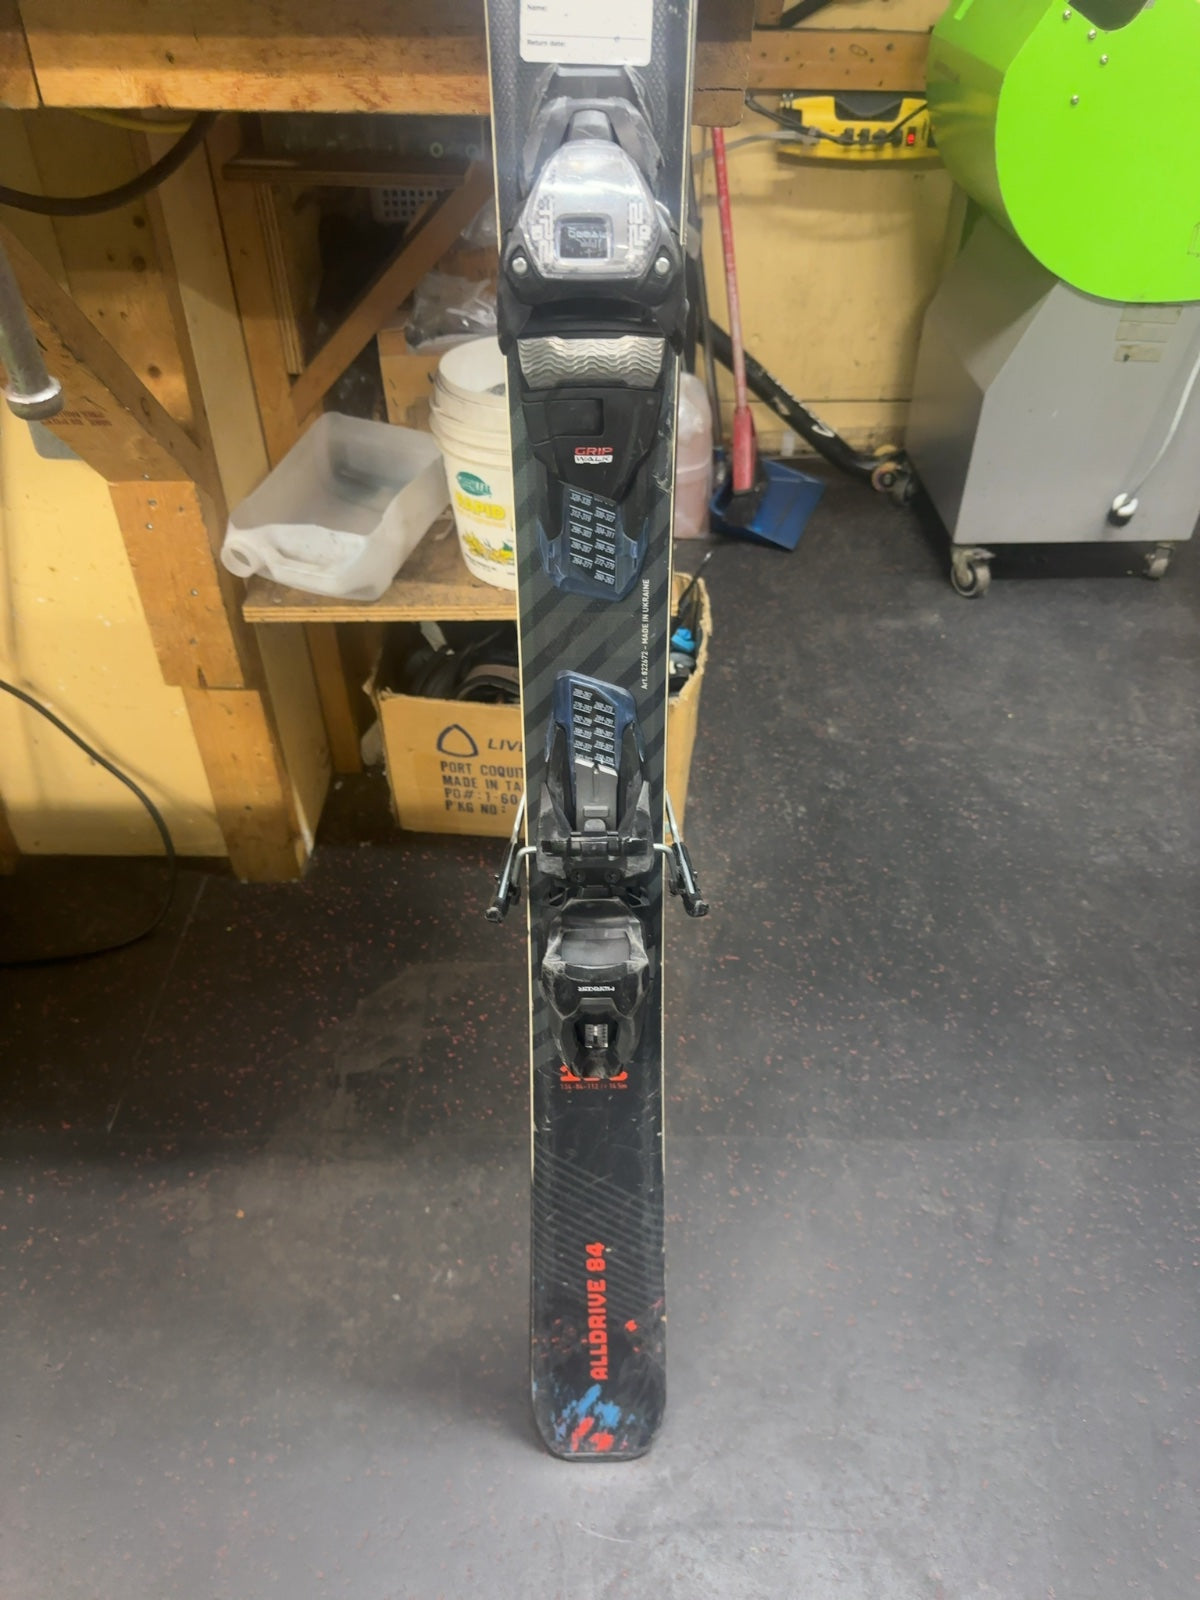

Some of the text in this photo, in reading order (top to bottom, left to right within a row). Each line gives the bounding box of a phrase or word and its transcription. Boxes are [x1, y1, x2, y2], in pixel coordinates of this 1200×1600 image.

[575, 447, 613, 455] GRIP
[575, 455, 613, 463] WALK
[642, 579, 650, 613] UKRAINE
[642, 614, 649, 623] IN
[641, 623, 649, 645] MADE
[641, 677, 649, 690] Art.
[440, 761, 472, 774] PORT
[442, 775, 478, 789] MADE
[485, 779, 498, 790] IN
[586, 1241, 608, 1380] ALLDRIVE 84
